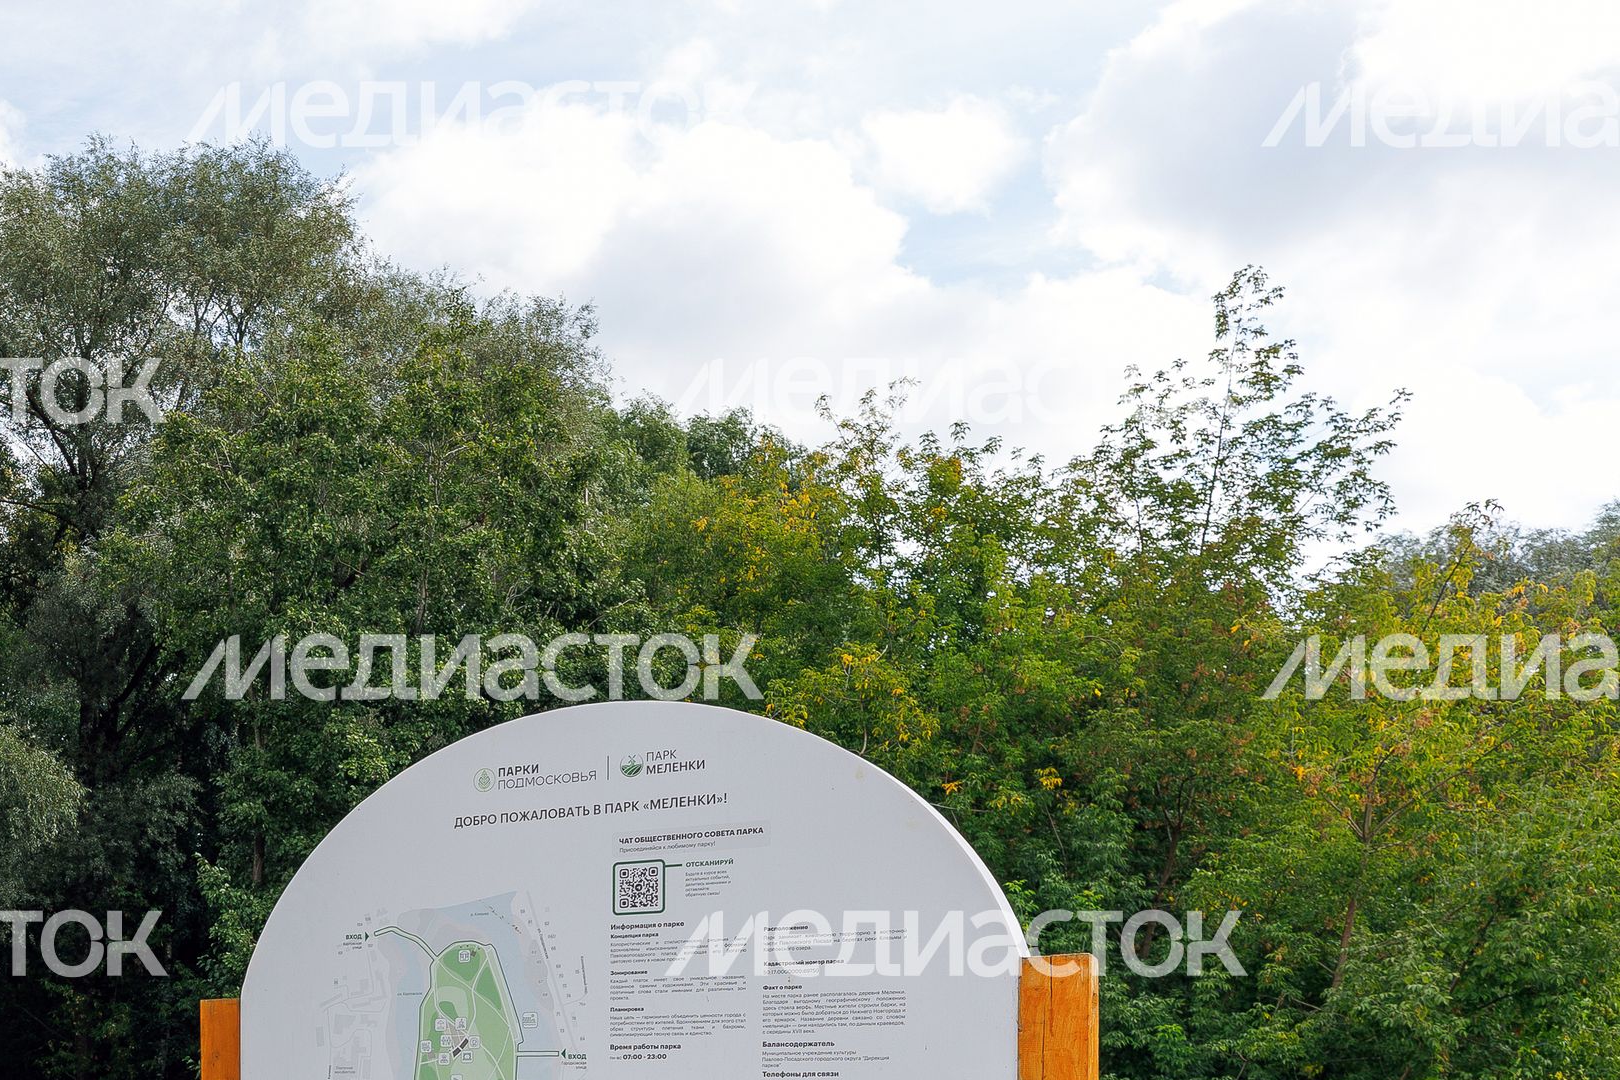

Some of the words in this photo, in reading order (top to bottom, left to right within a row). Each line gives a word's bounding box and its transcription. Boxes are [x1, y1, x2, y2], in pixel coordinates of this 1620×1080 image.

[647, 749, 676, 761] ПАРК
[499, 764, 538, 777] ПАРКИ
[647, 760, 705, 774] МЕЛЕНКИ
[498, 770, 596, 790] ПОДМОСКОВЬЯ
[454, 814, 497, 828] ДОБРО
[501, 805, 590, 823] ПОЖАЛОВАТЬ
[594, 804, 601, 815] В
[605, 801, 639, 814] ПАРК
[644, 793, 727, 810] «МЕЛЕНКИ»!
[634, 832, 703, 843] ОБЩЕСТВЕННОГО
[736, 827, 763, 835] ПАРКА
[686, 858, 733, 867] ОТСКАНИРУЙ
